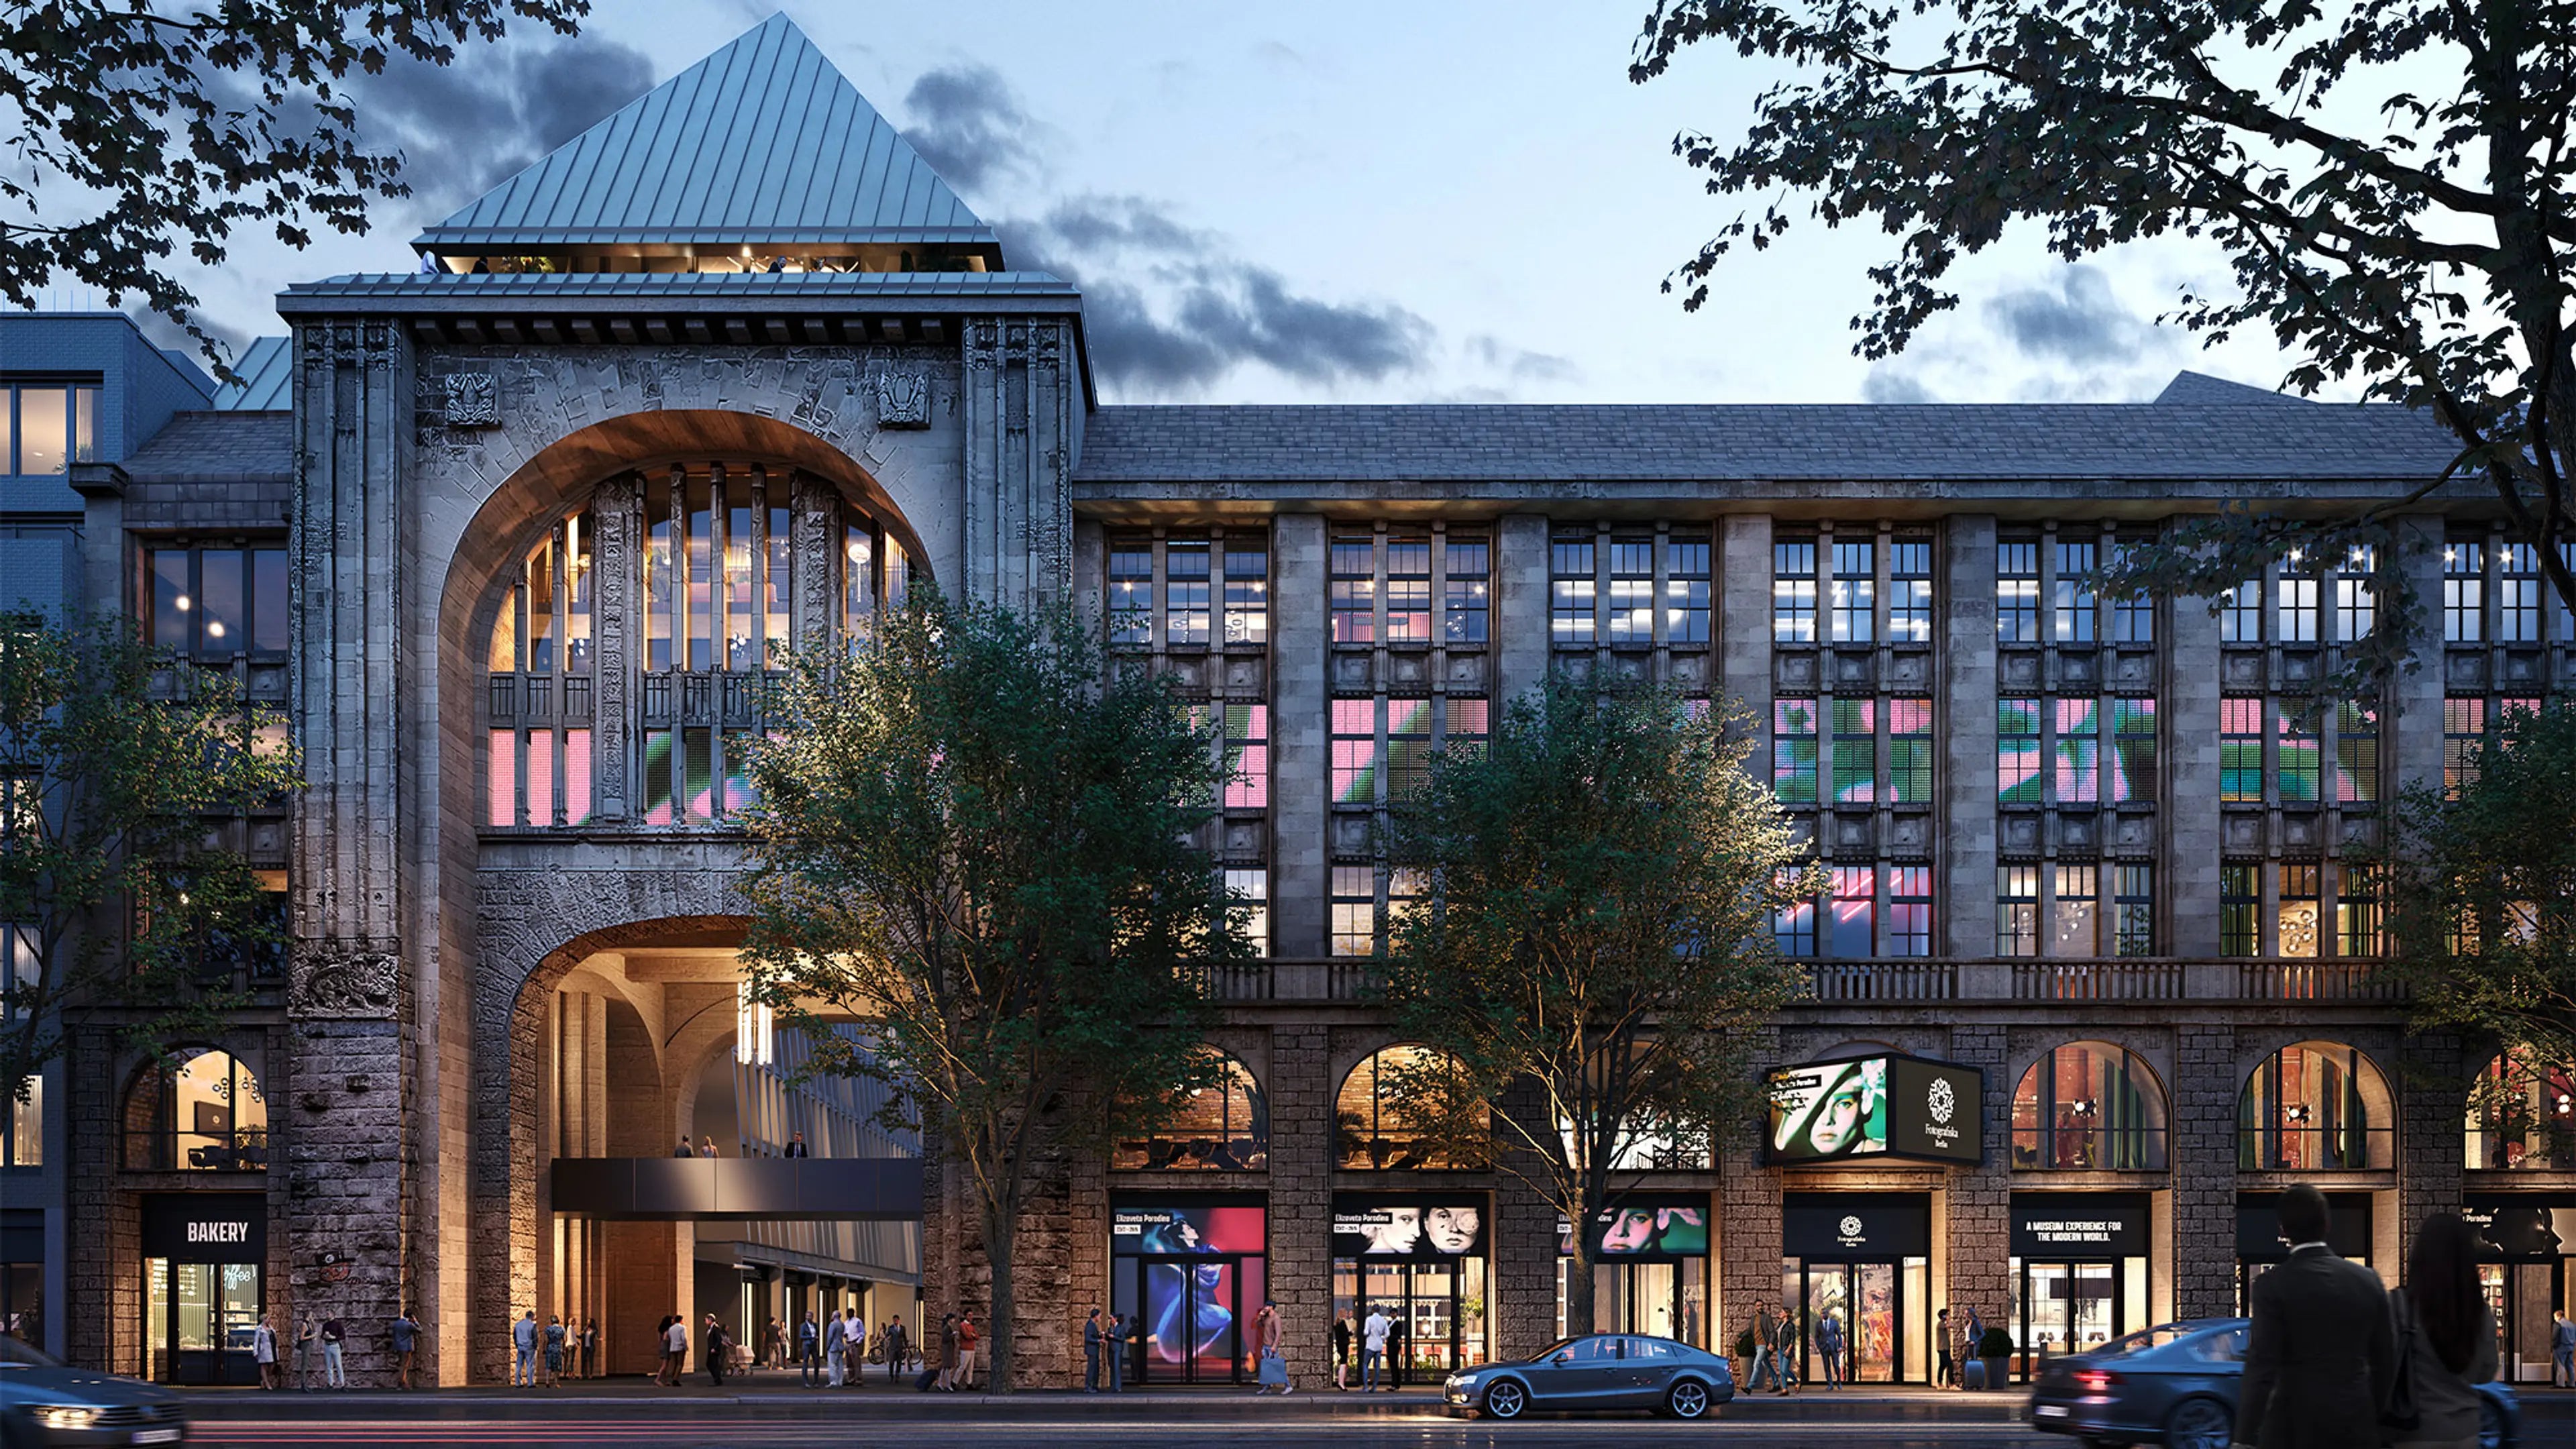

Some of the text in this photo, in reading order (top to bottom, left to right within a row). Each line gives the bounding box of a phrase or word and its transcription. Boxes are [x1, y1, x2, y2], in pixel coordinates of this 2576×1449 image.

[2026, 1221, 2122, 1231] A MUSEUM EXPERIENCE FOR
[187, 1222, 248, 1242] BAKERY
[2037, 1232, 2111, 1242] THE MODERN WORLD.
